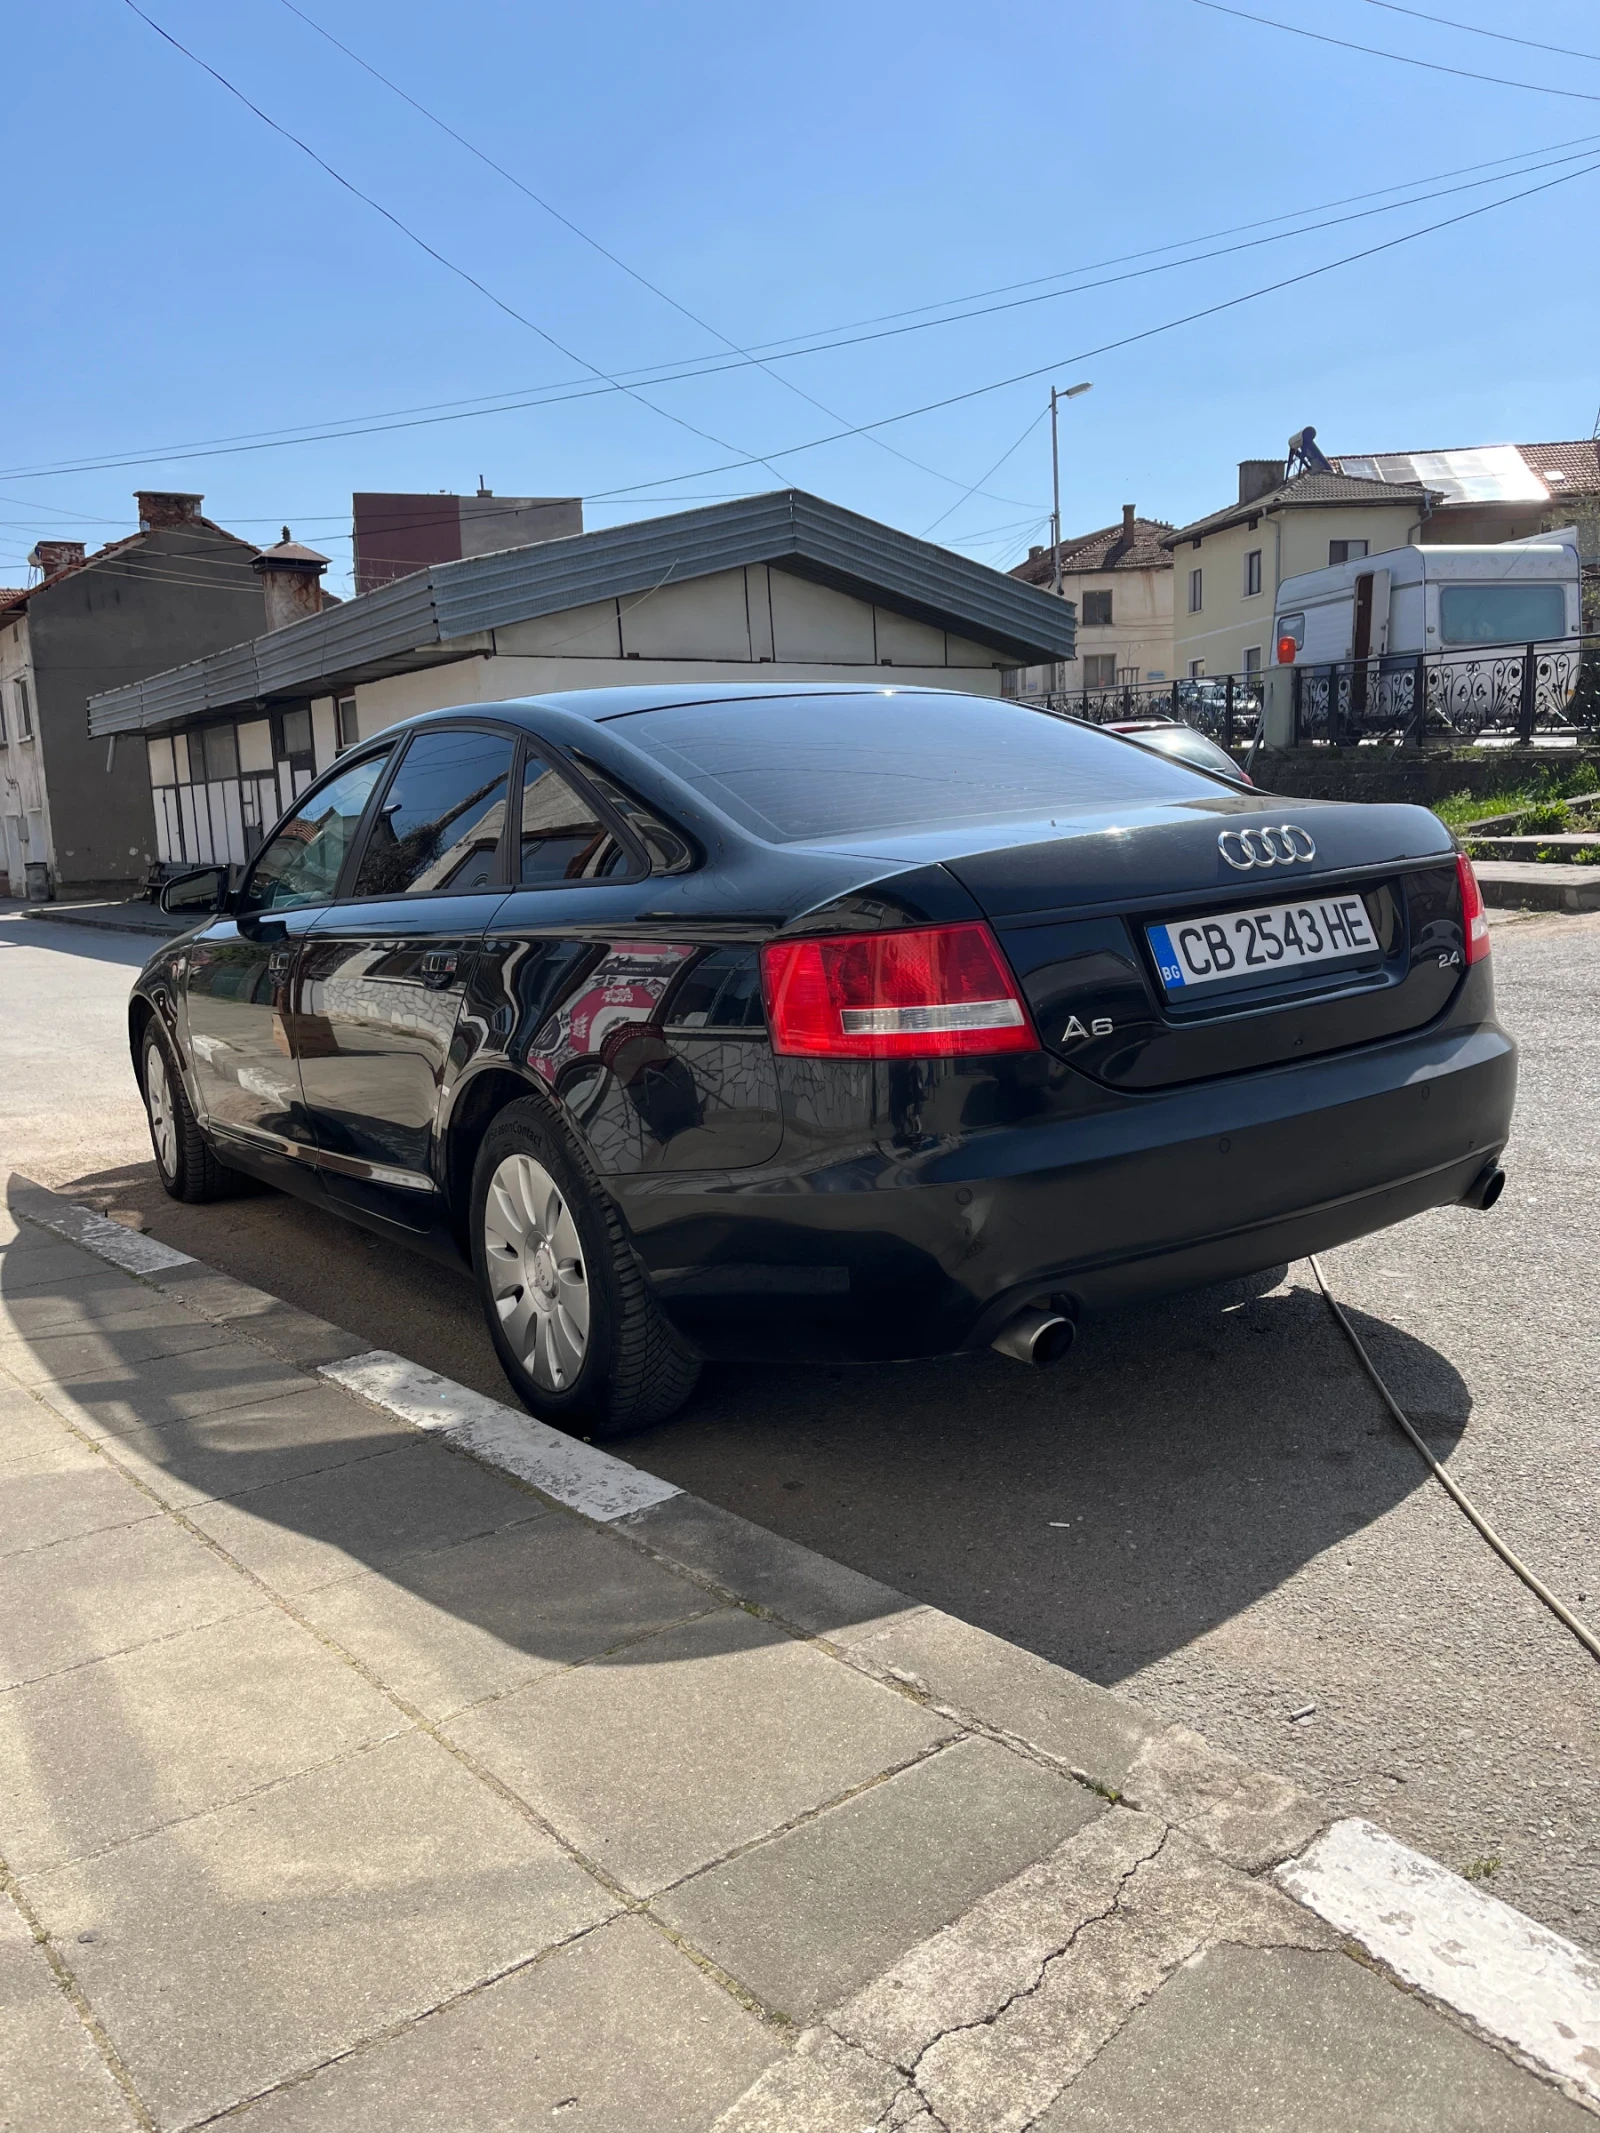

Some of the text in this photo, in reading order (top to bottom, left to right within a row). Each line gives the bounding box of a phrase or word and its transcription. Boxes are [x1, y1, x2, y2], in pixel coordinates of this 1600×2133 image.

[1179, 901, 1371, 975] CB 2543 HE
[1162, 964, 1181, 982] BG
[1061, 1015, 1114, 1042] A6
